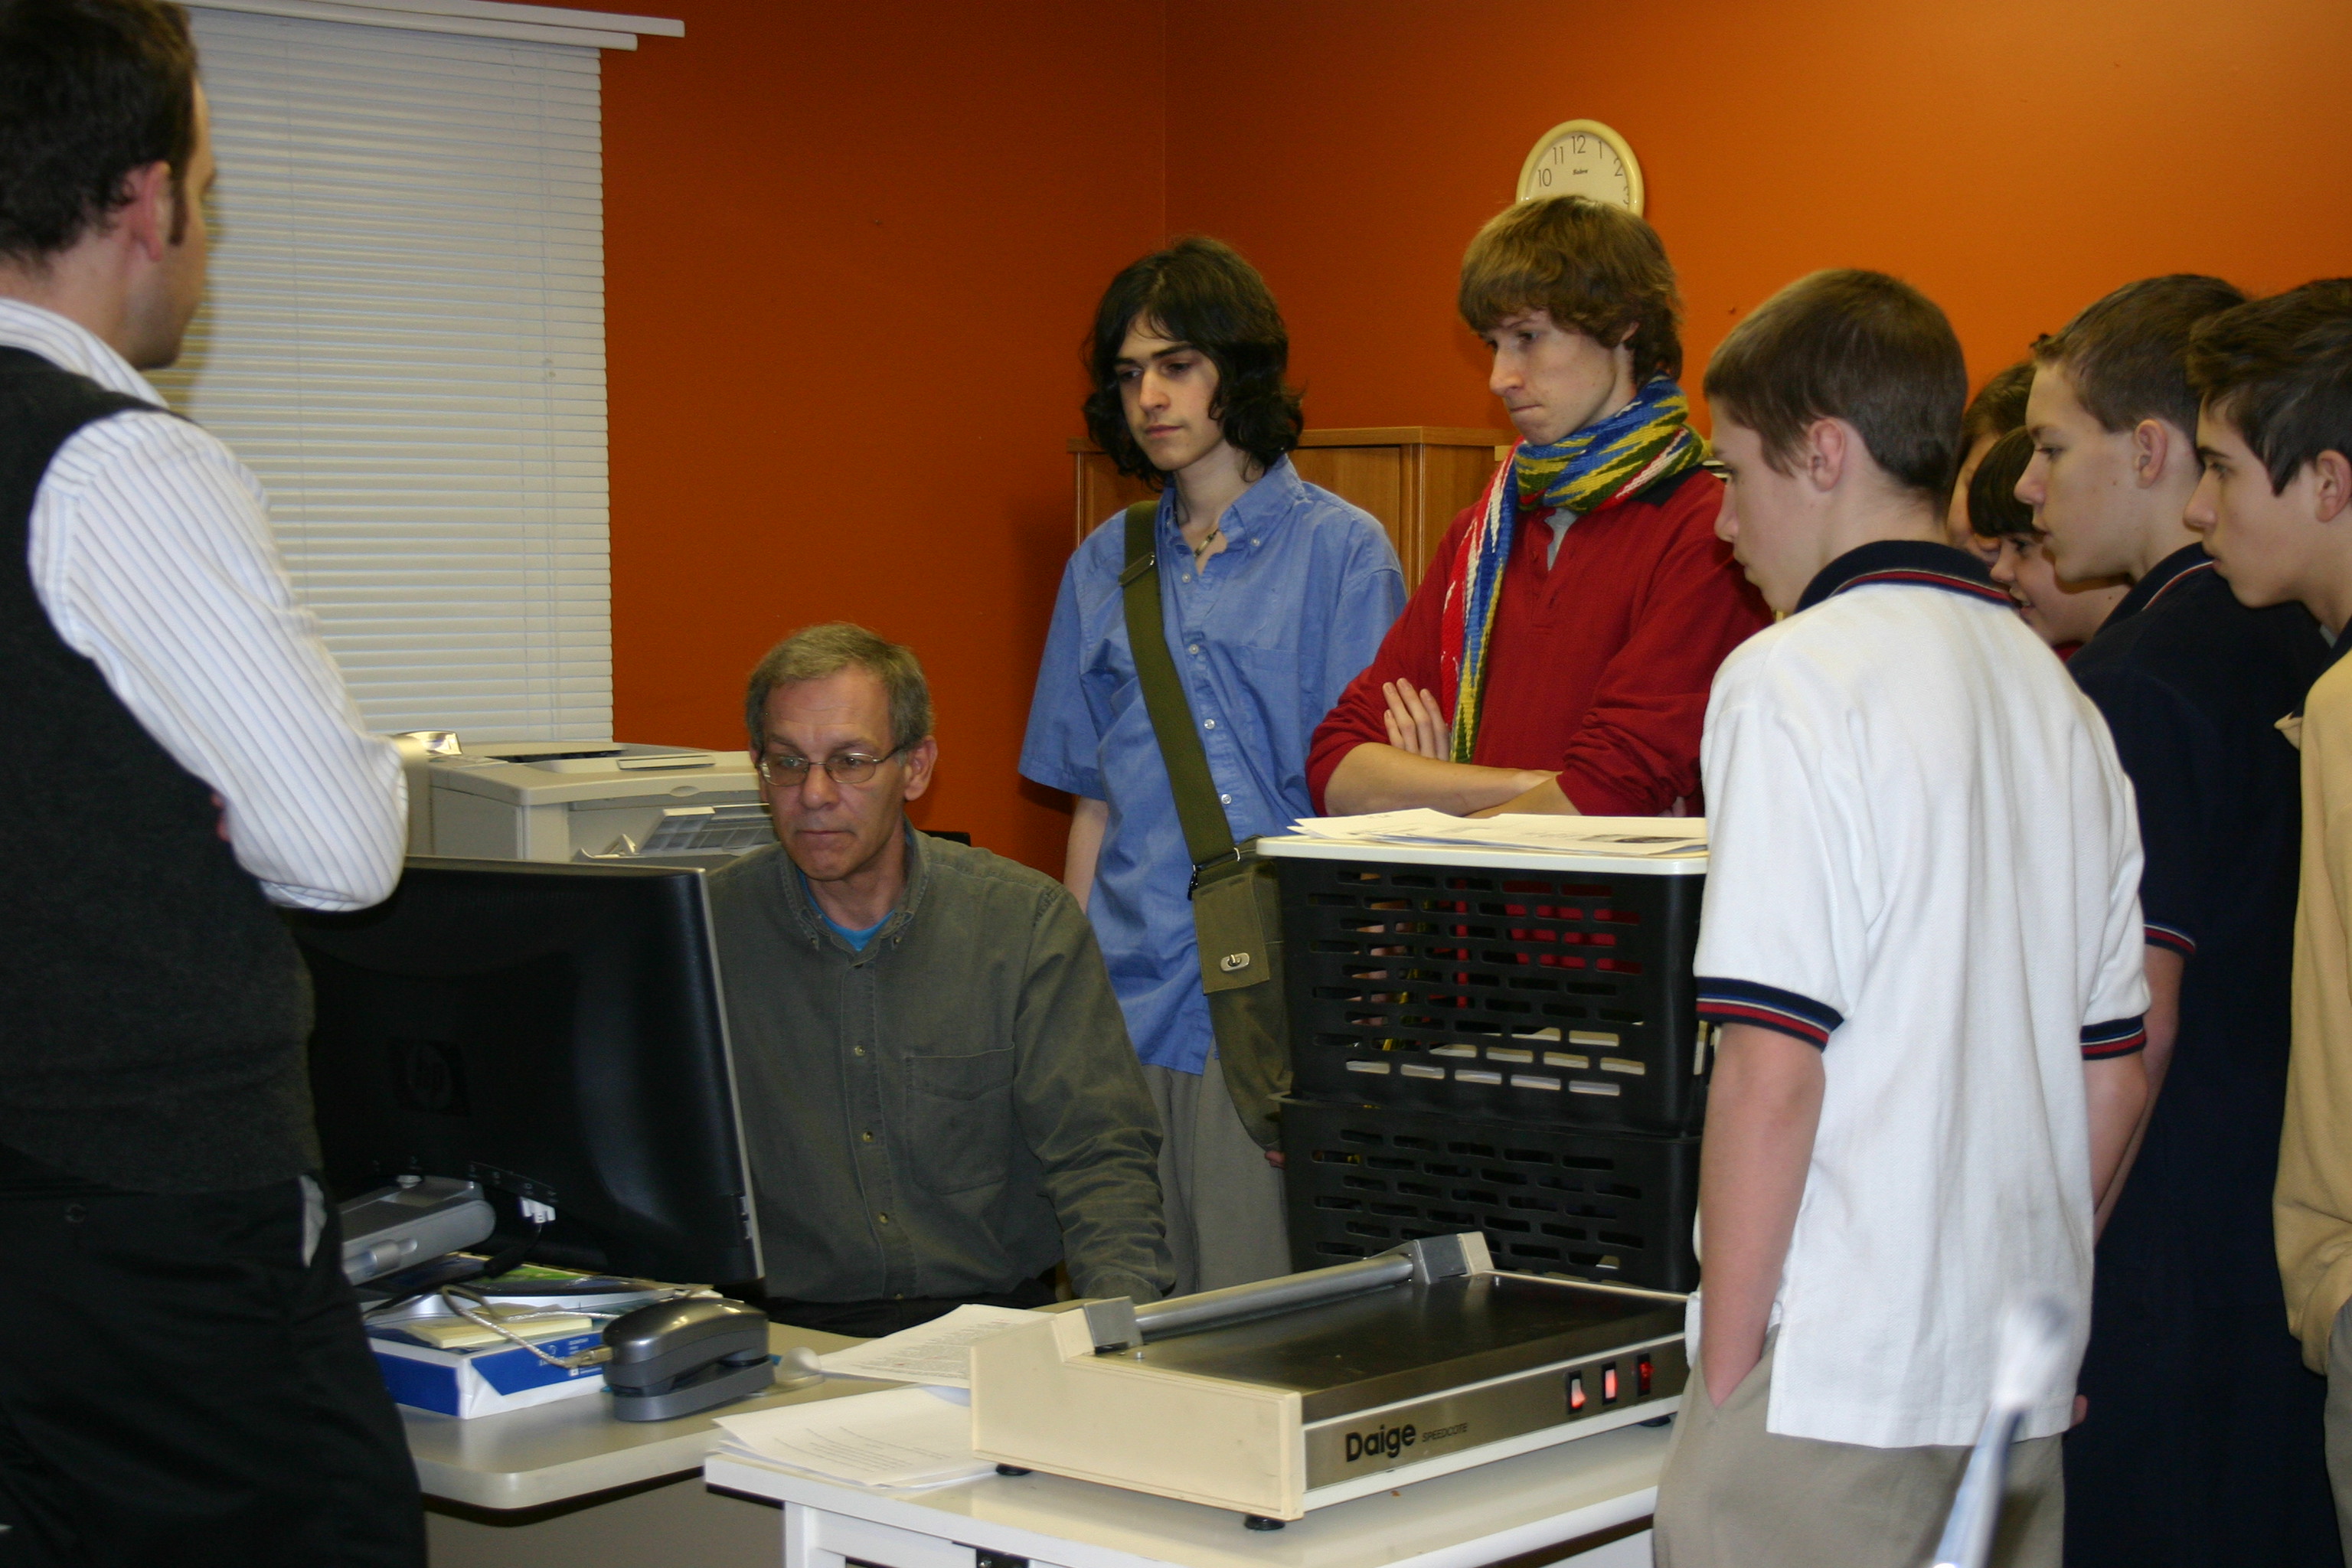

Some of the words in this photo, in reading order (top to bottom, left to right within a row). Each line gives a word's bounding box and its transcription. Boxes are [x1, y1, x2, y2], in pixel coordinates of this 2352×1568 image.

[1572, 135, 1586, 154] 12
[1599, 141, 1602, 159] 1
[1553, 146, 1563, 165] 11
[1614, 157, 1623, 176] 2
[1538, 168, 1552, 187] 10
[1345, 1423, 1416, 1462] Daige
